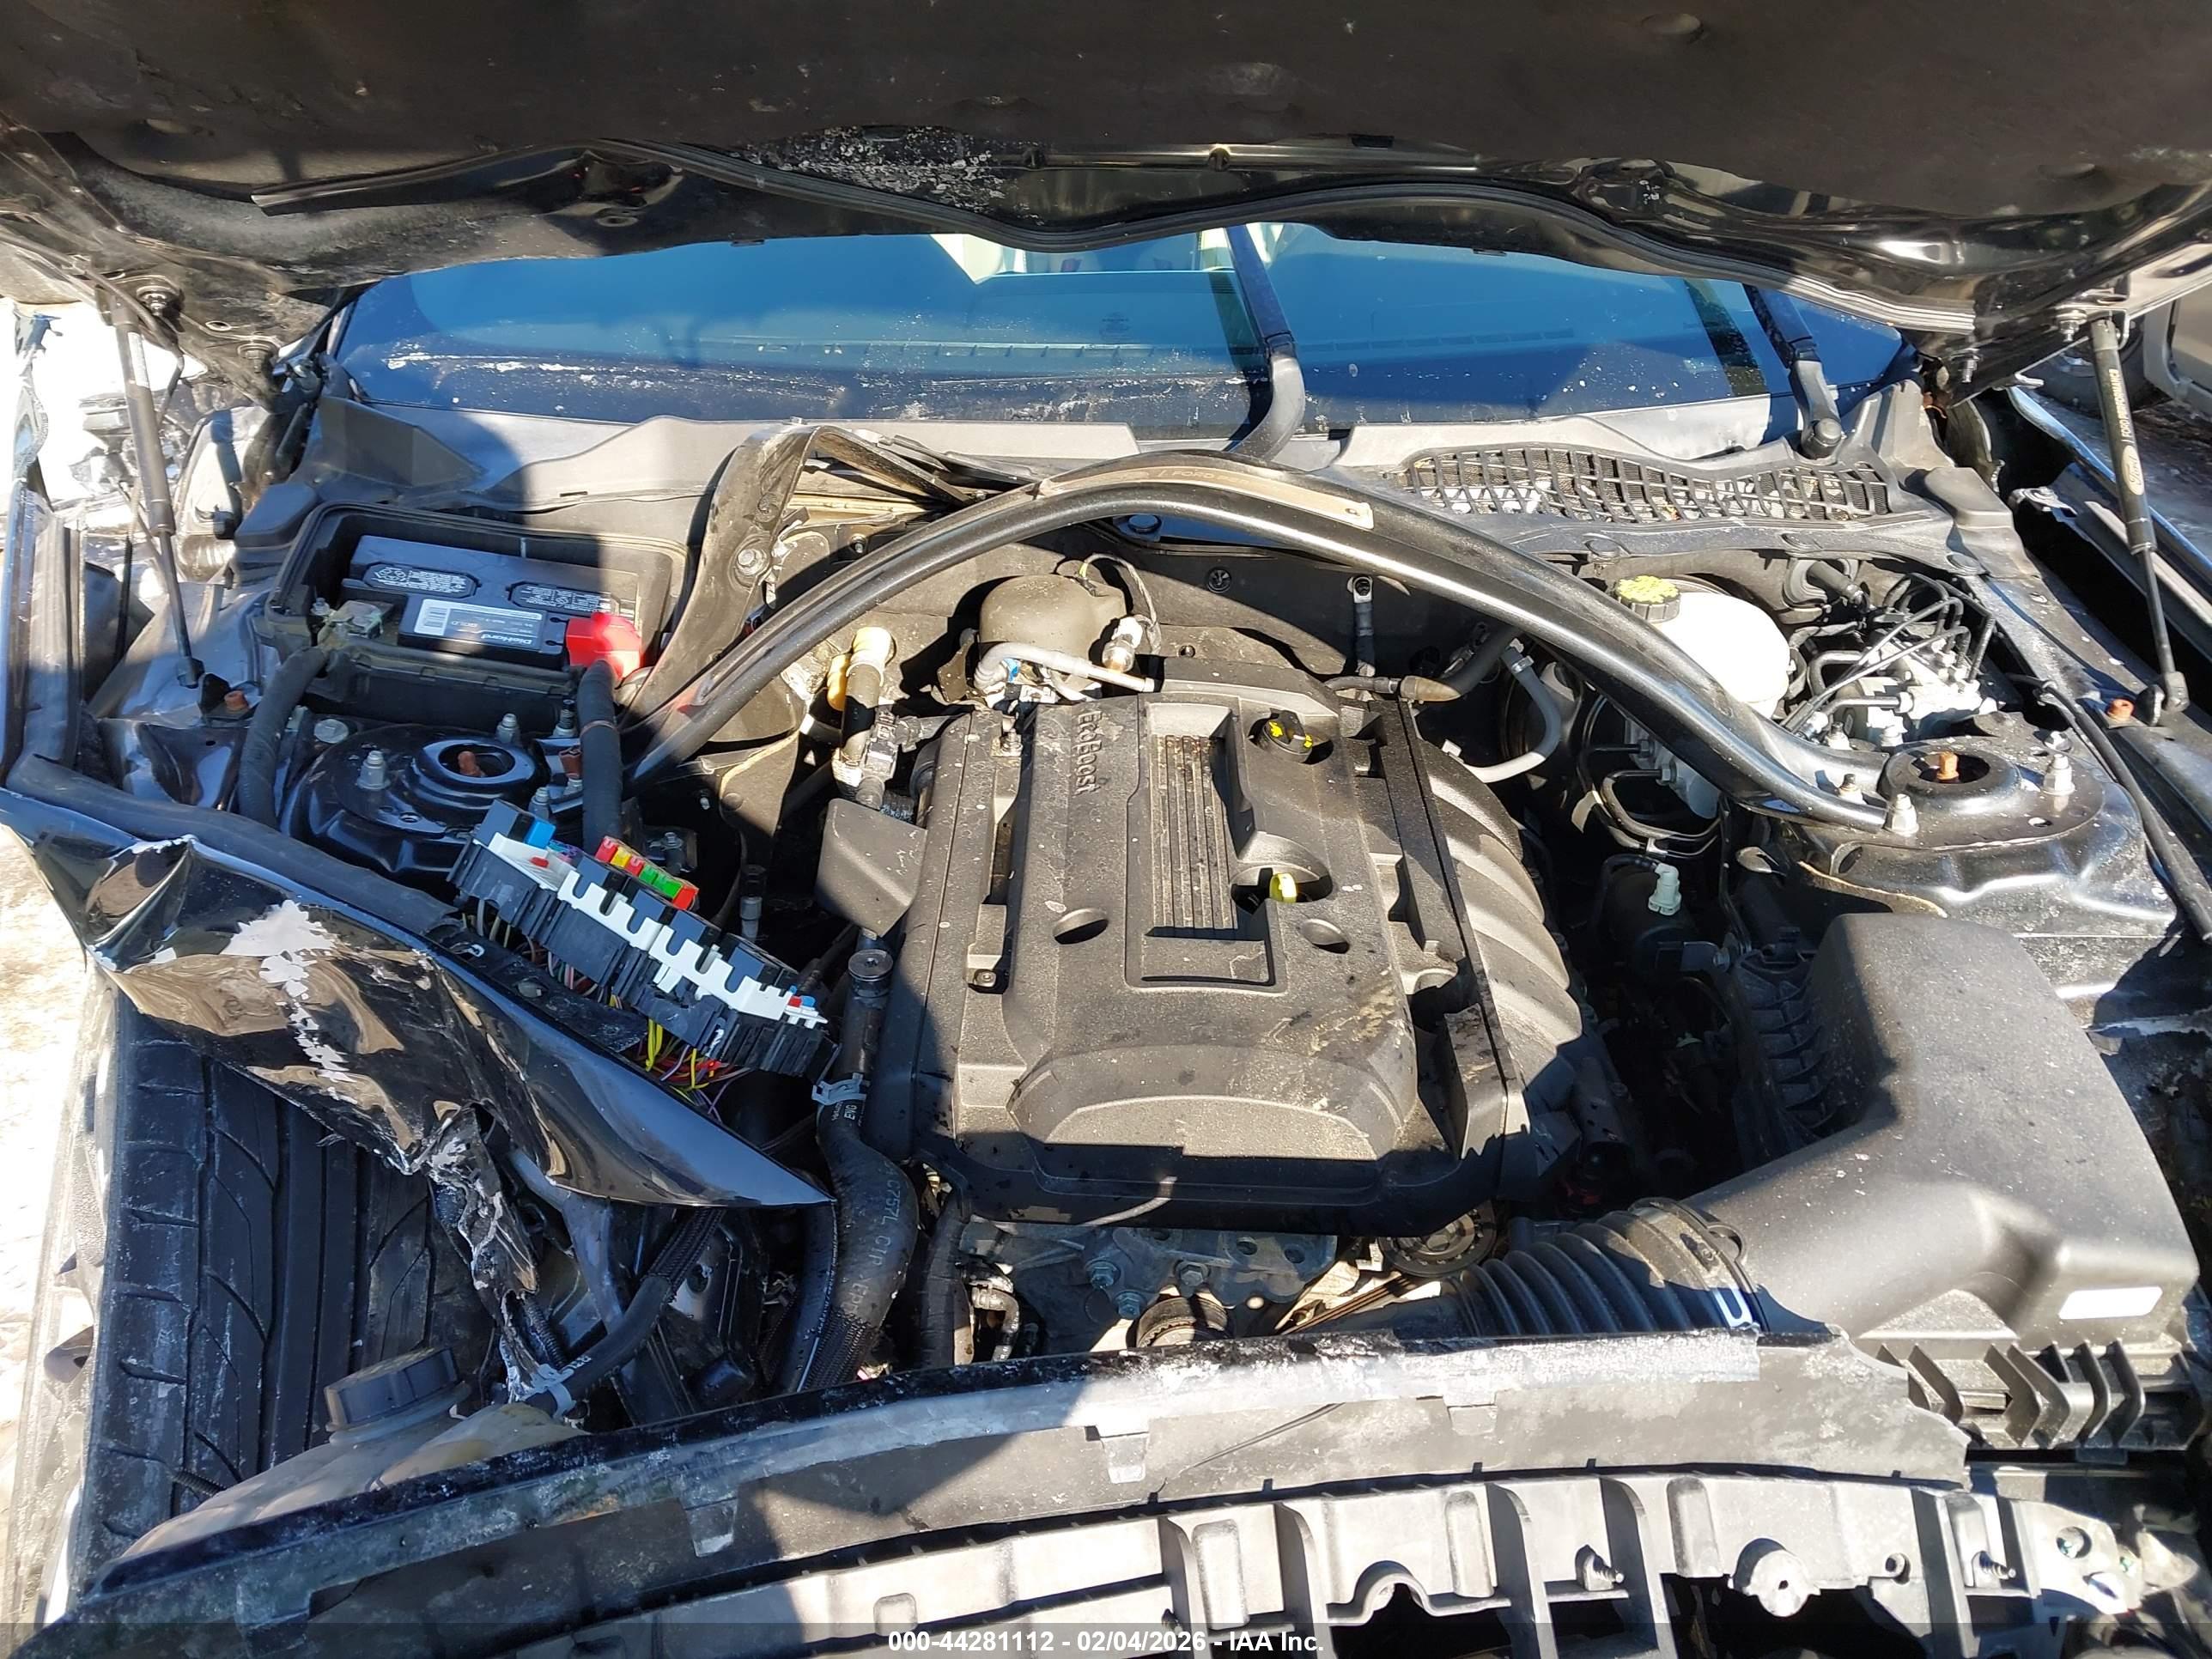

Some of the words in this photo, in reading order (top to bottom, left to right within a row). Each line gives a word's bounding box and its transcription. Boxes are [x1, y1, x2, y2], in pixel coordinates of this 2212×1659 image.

[2119, 420, 2132, 437] FORD
[481, 634, 532, 645] DieHard
[1073, 710, 1103, 795] EcoBoost
